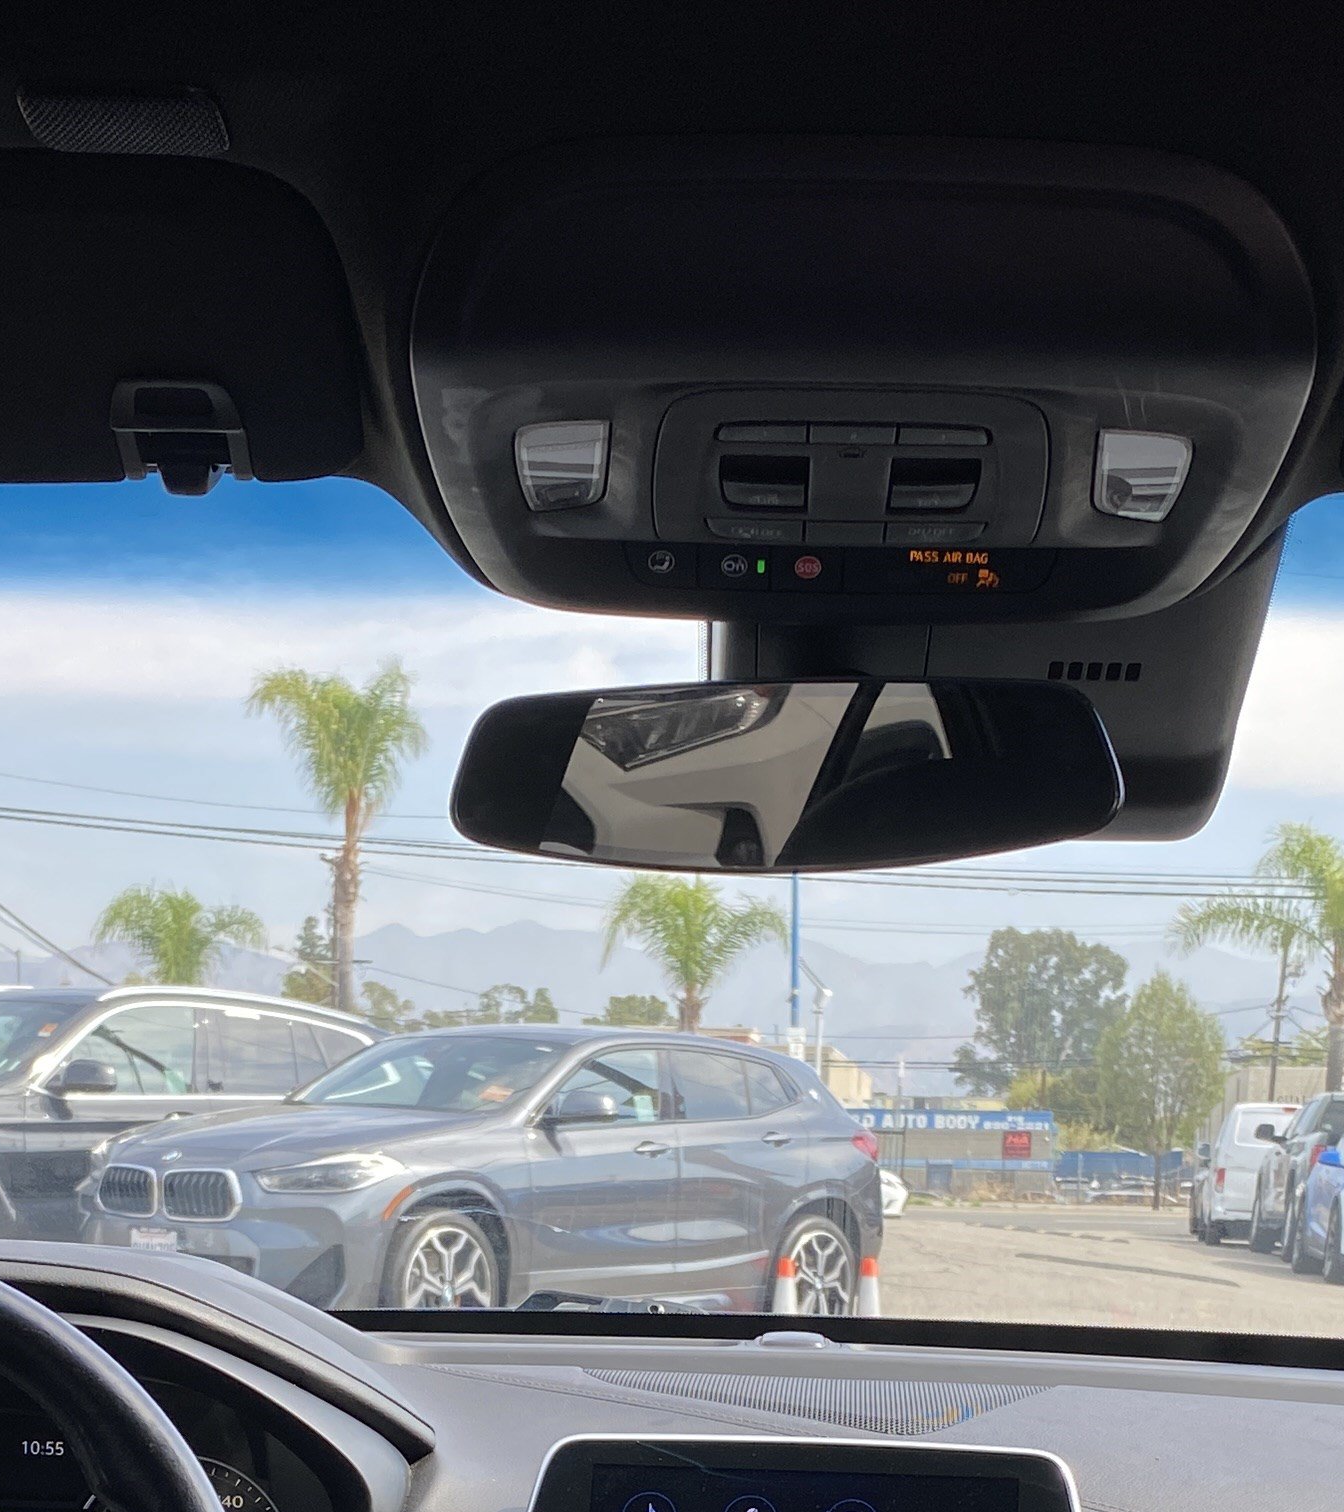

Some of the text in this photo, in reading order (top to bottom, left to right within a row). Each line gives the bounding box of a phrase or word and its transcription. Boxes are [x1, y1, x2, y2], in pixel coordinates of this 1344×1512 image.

[909, 550, 990, 565] PASS AIR BAG
[797, 560, 820, 573] SOS
[947, 572, 969, 585] OFF
[881, 1114, 928, 1129] AUTO
[933, 1114, 981, 1130] BODY
[21, 1440, 65, 1457] 10:55
[219, 1494, 244, 1510] 40
